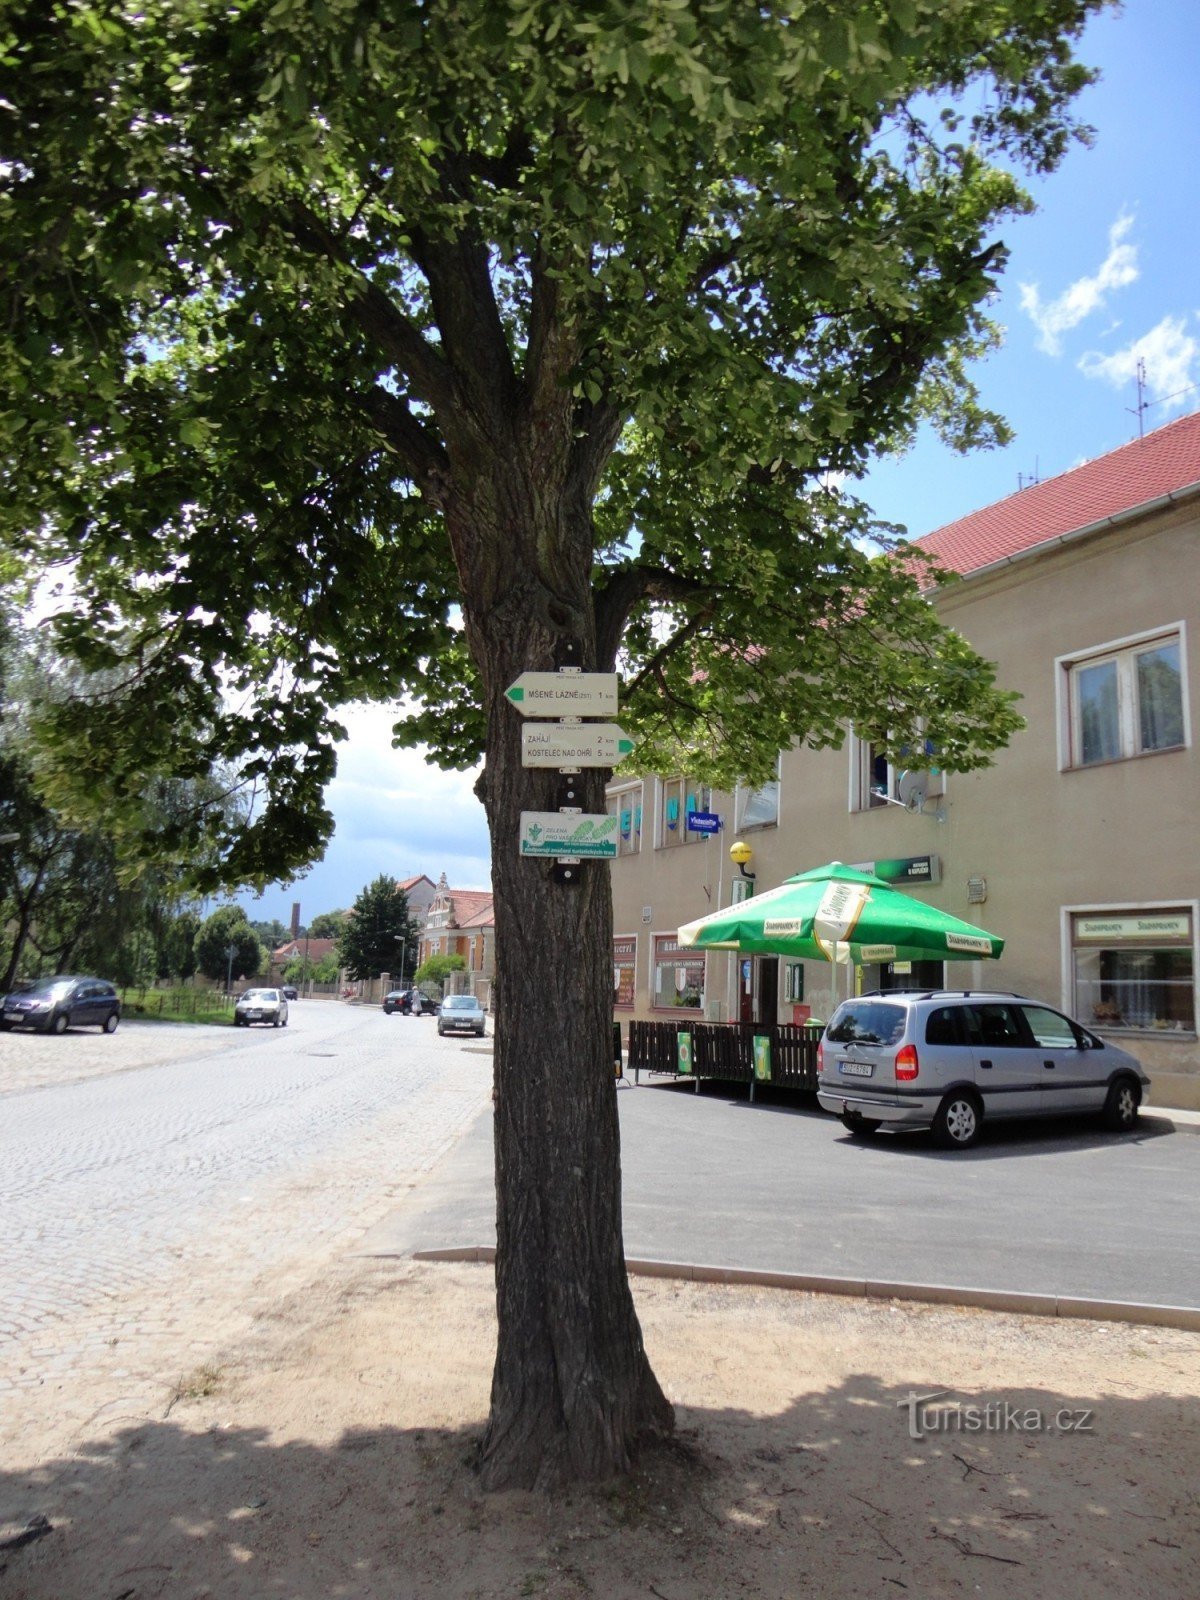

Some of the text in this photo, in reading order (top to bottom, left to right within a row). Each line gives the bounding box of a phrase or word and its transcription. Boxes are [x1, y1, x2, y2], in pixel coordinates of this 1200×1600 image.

[528, 689, 553, 699] MŠENÉ
[598, 691, 603, 699] 1
[597, 735, 603, 744] 2
[527, 749, 560, 757] KOSTELEC
[562, 749, 576, 757] NAD
